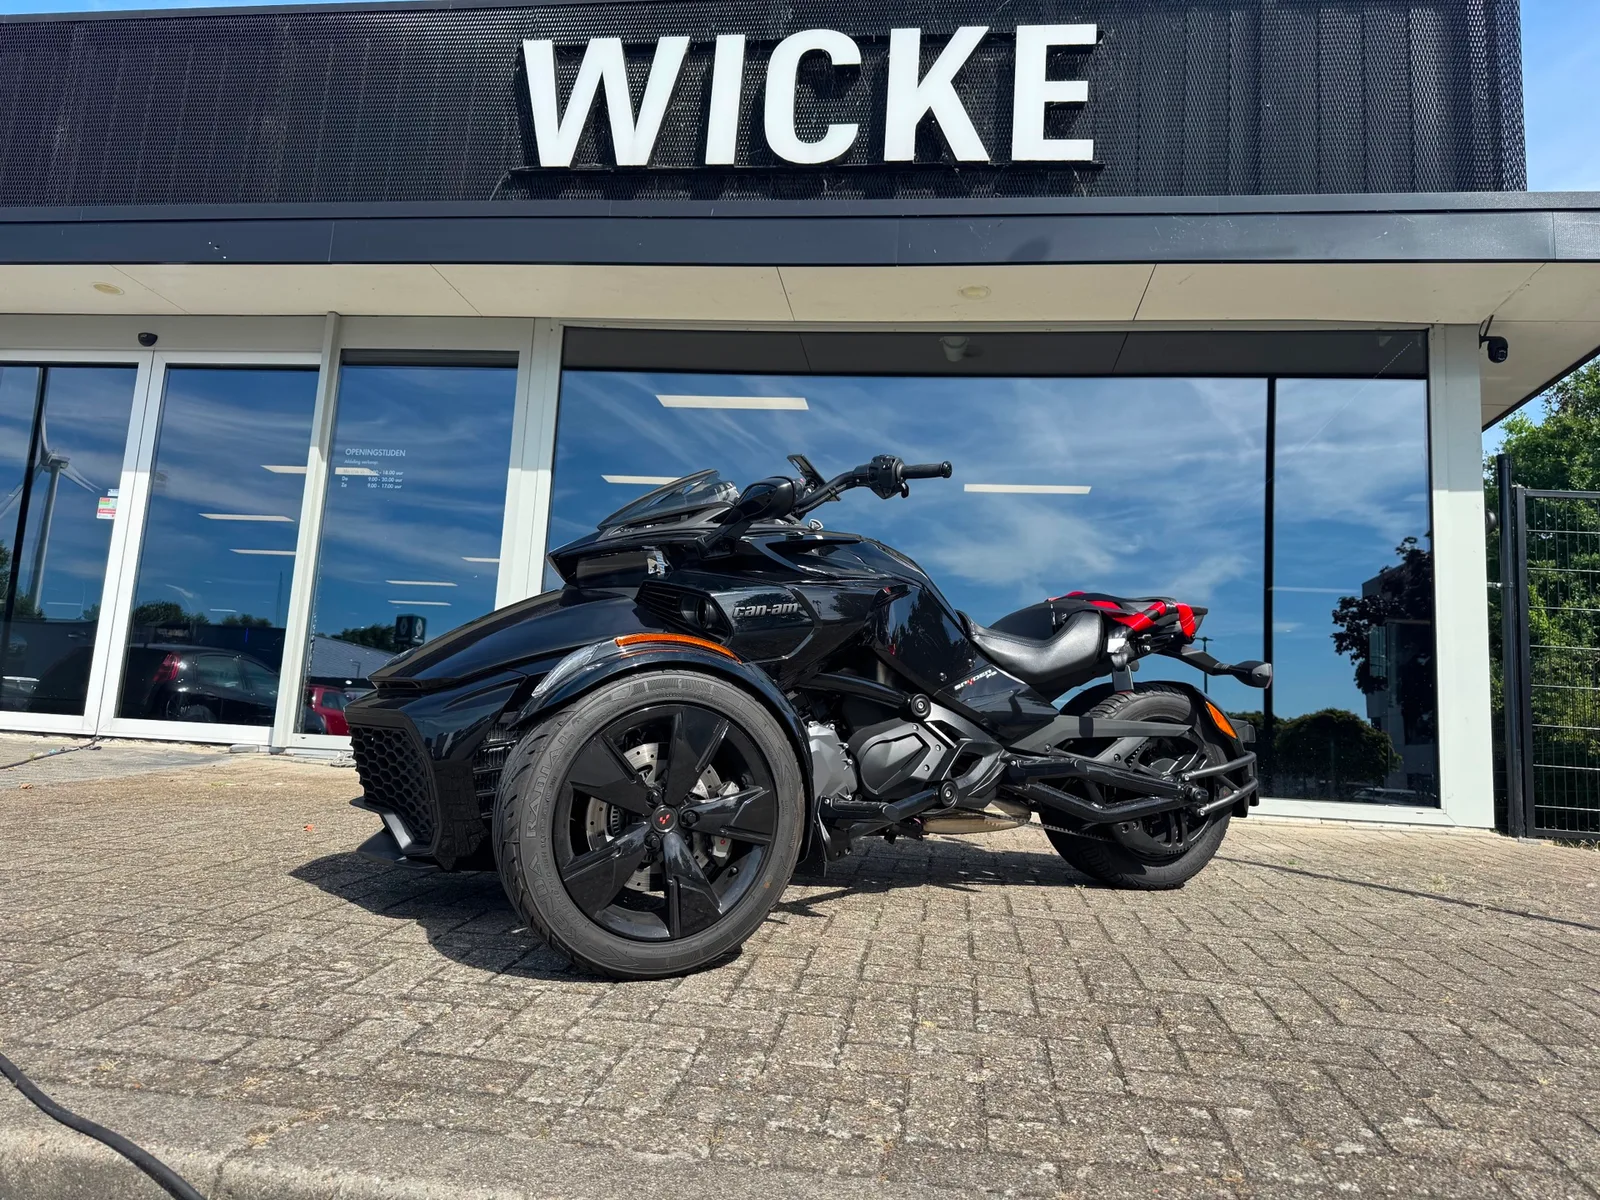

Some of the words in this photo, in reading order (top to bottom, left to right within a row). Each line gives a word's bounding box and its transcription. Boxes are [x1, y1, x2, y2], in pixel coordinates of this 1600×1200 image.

[522, 24, 1098, 167] WICKE
[345, 448, 406, 457] OPENINGSTIJDEN
[732, 602, 798, 618] can-am
[525, 733, 575, 838] RADIAL
[528, 852, 584, 945] KENDA
